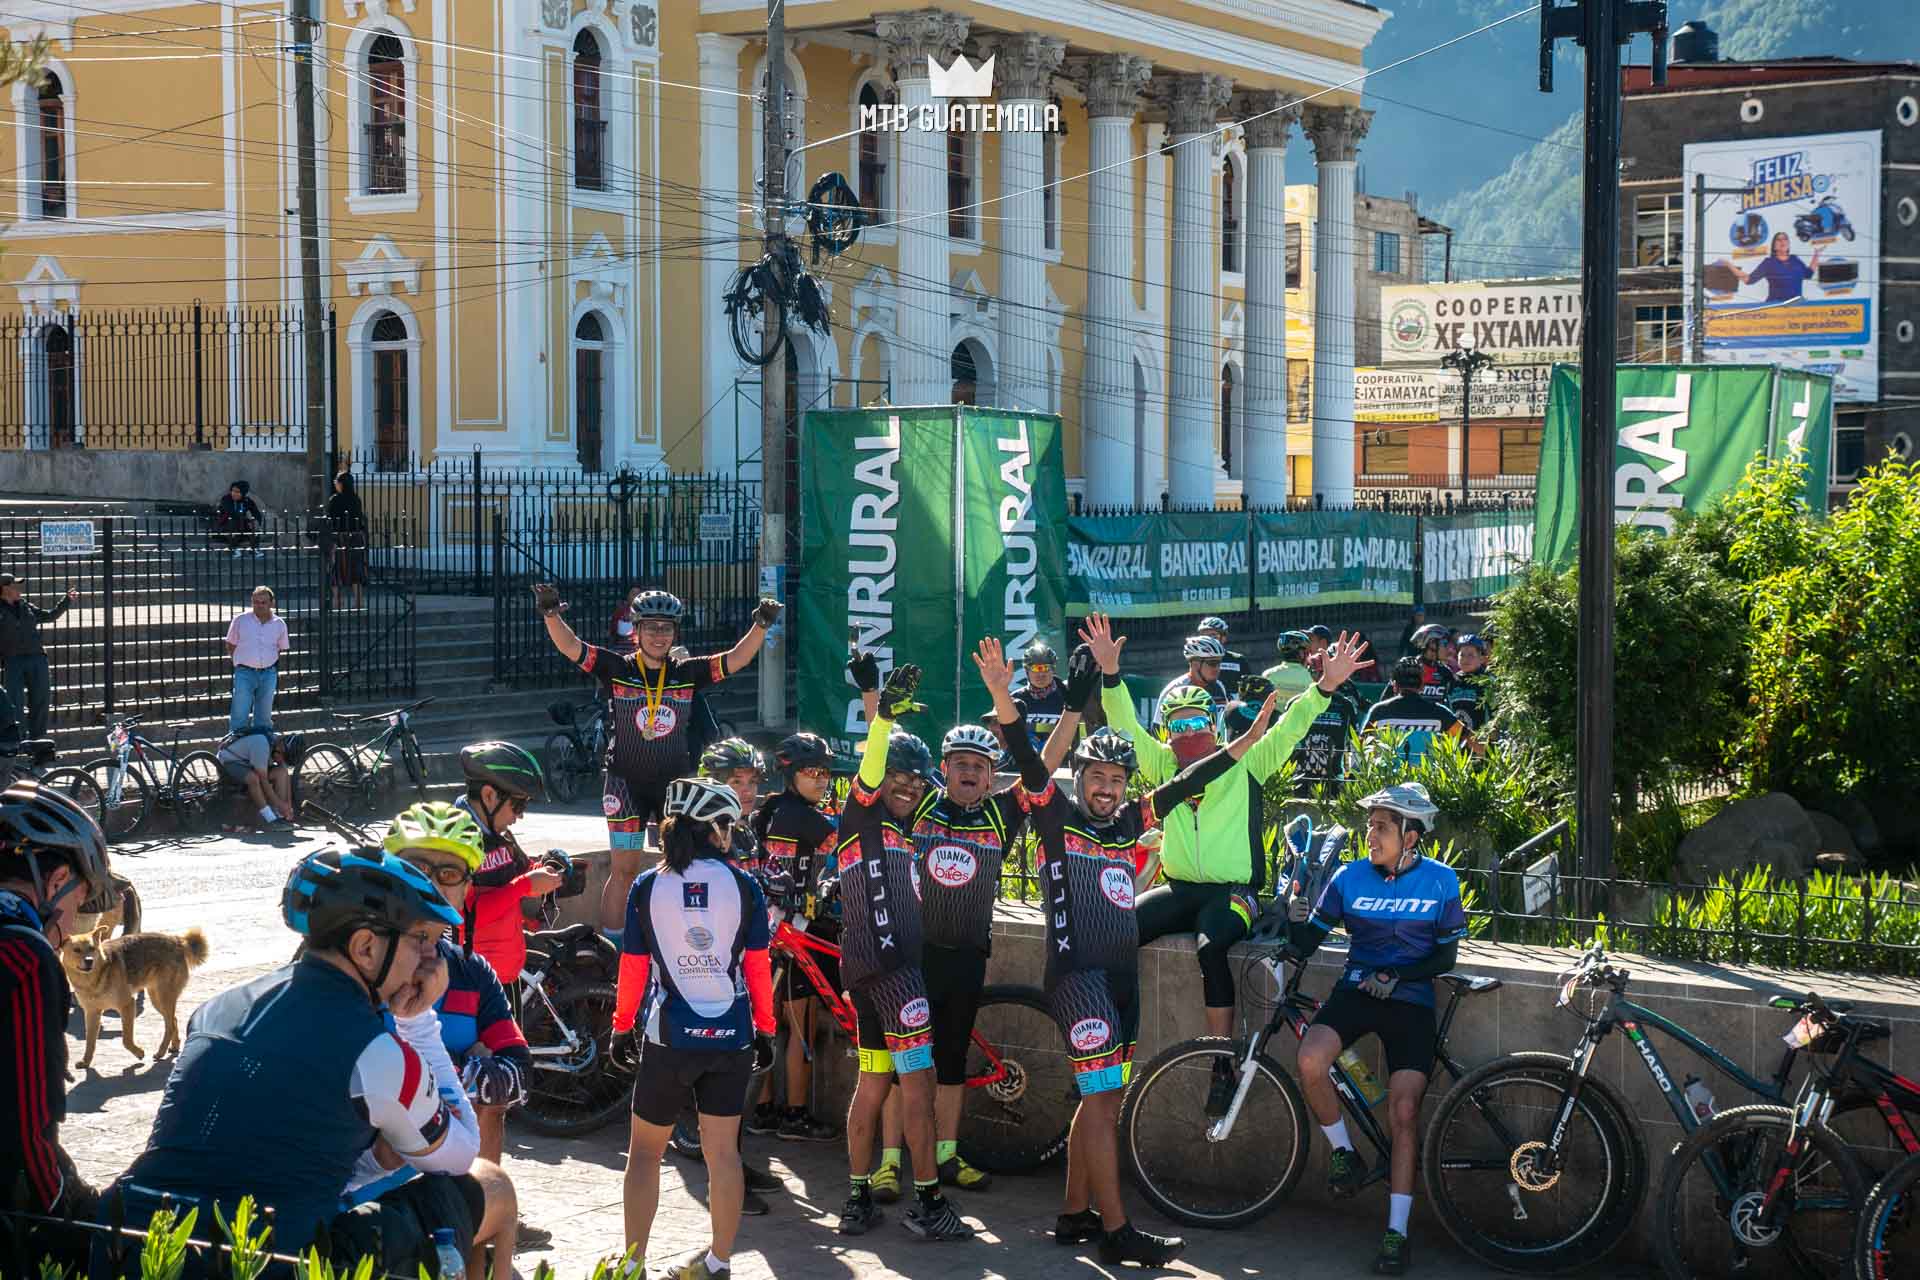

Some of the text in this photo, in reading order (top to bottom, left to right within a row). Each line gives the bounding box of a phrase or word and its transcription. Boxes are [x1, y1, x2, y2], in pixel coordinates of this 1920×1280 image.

[1755, 153, 1802, 185] FELIZ
[1356, 375, 1424, 385] COOPERATIVA
[1454, 405, 1497, 415] ABGADOS
[1354, 489, 1434, 501] OOPRATIV
[1161, 541, 1248, 577] BANRURAL
[1258, 538, 1336, 573] BANRURAL
[935, 850, 972, 866] JUANKA
[935, 863, 969, 879] bikes
[868, 859, 895, 950] XELA
[1051, 861, 1070, 953] XELA
[1351, 896, 1439, 913] GIANT
[1072, 1021, 1103, 1038] JUANKA
[1636, 1039, 1672, 1093] HARO
